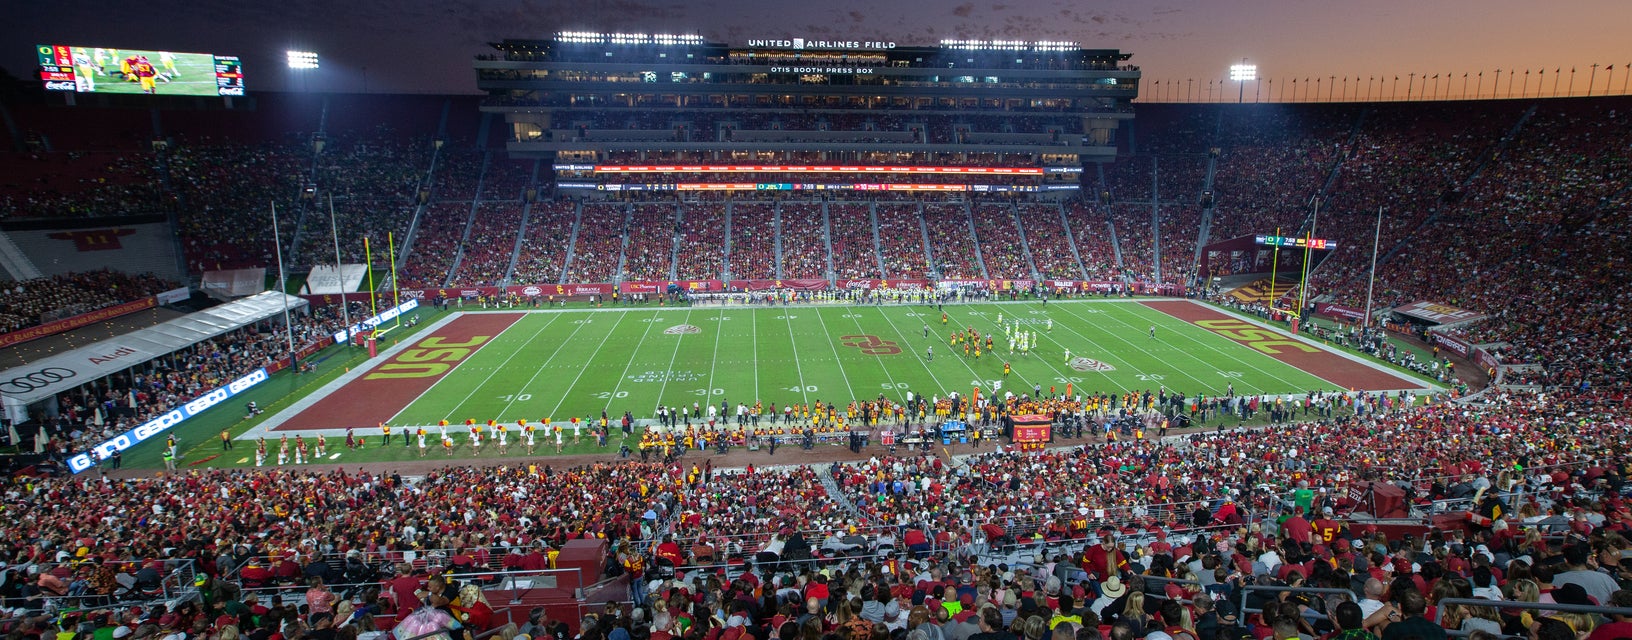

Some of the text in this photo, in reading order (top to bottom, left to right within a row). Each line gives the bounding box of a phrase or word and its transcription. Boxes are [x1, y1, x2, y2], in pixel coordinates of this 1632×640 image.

[748, 39, 896, 49] UNITED AIRLINES FIELD
[1194, 319, 1322, 354] USC
[88, 346, 136, 366] Audi
[363, 336, 491, 380] USC
[229, 370, 266, 394] GEICO
[184, 388, 228, 416] GEICO
[134, 410, 184, 441] GEICO
[1076, 520, 1086, 529] 10
[1324, 528, 1333, 541] 5
[632, 562, 642, 571] 55
